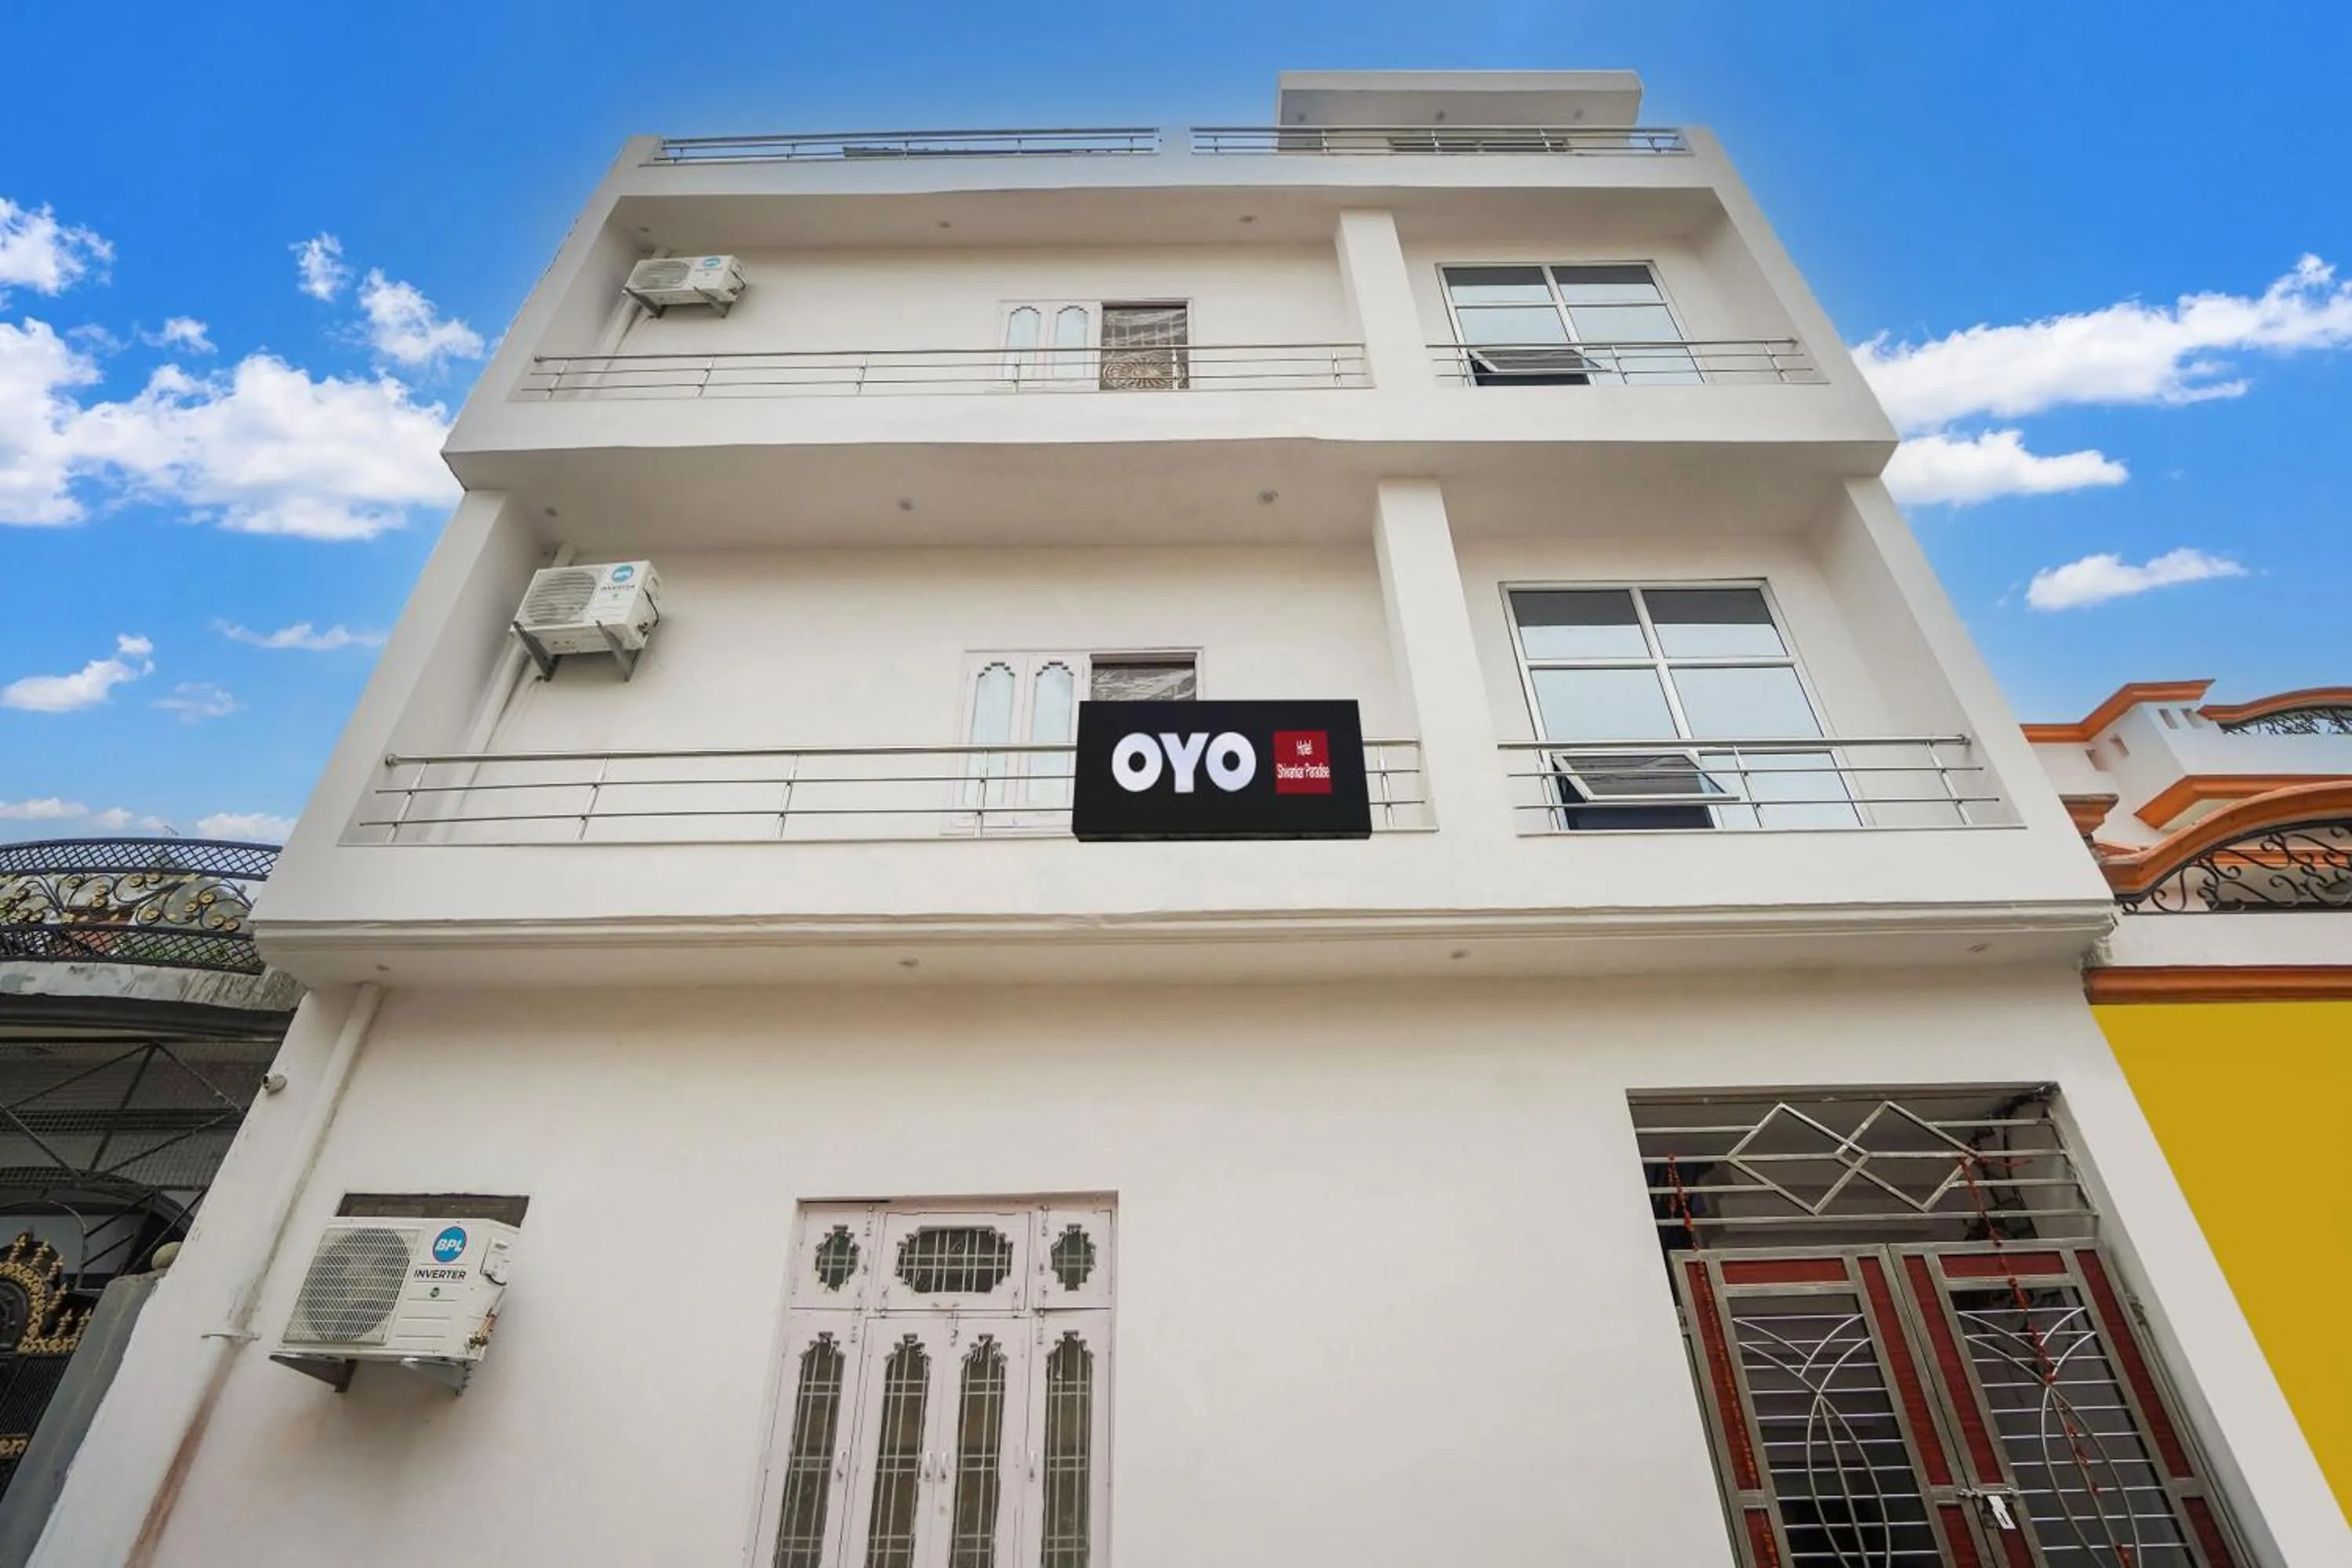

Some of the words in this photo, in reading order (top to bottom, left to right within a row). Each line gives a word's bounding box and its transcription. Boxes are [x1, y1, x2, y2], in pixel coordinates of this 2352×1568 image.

[1296, 739, 1312, 756] Hotel
[1112, 731, 1256, 793] OYO
[434, 1239, 463, 1252] BPL
[413, 1269, 466, 1280] INVERTER
